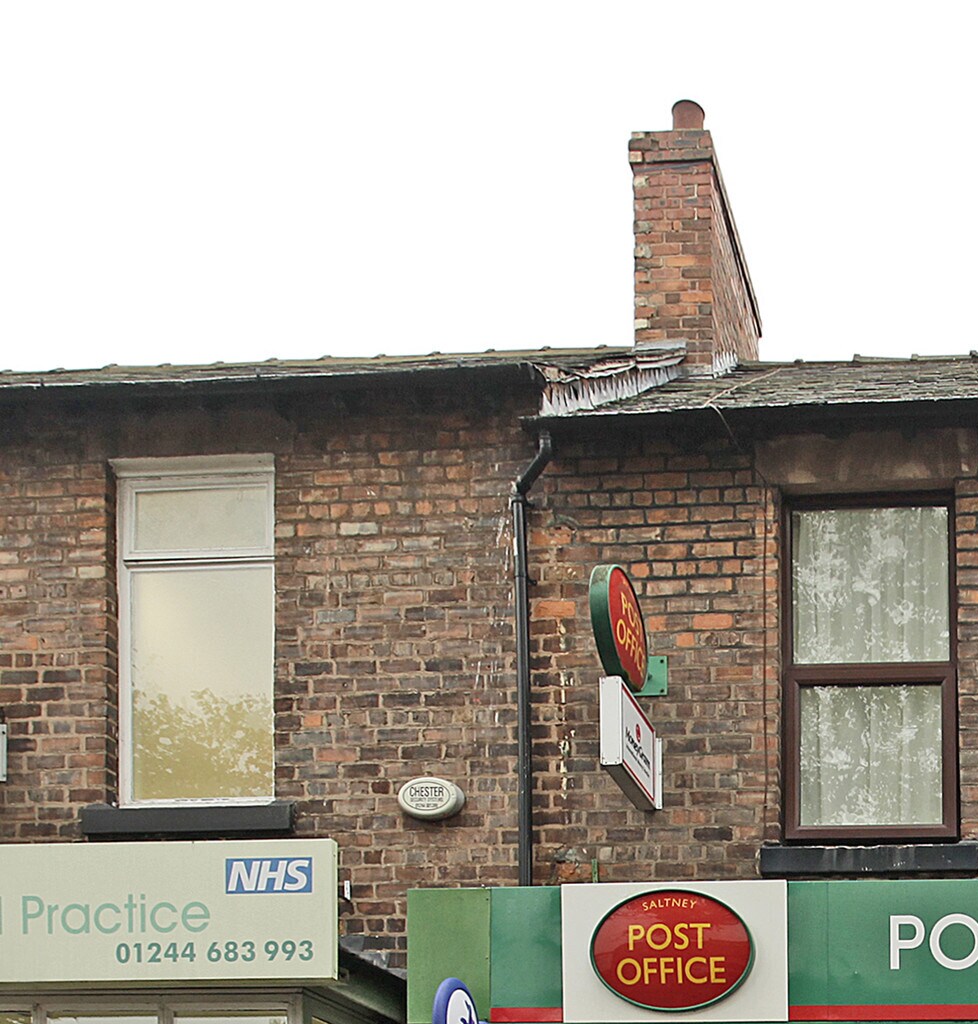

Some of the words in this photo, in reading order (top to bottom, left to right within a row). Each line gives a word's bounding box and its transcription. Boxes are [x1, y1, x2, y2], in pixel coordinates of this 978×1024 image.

[410, 786, 445, 797] CHESTER
[228, 860, 309, 892] NHS
[21, 894, 210, 935] Practice
[642, 898, 697, 911] SALTNEY
[628, 923, 711, 951] POST
[116, 942, 196, 963] 01244
[207, 941, 256, 962] 683
[264, 940, 314, 961] 993
[616, 957, 726, 985] OFFICE
